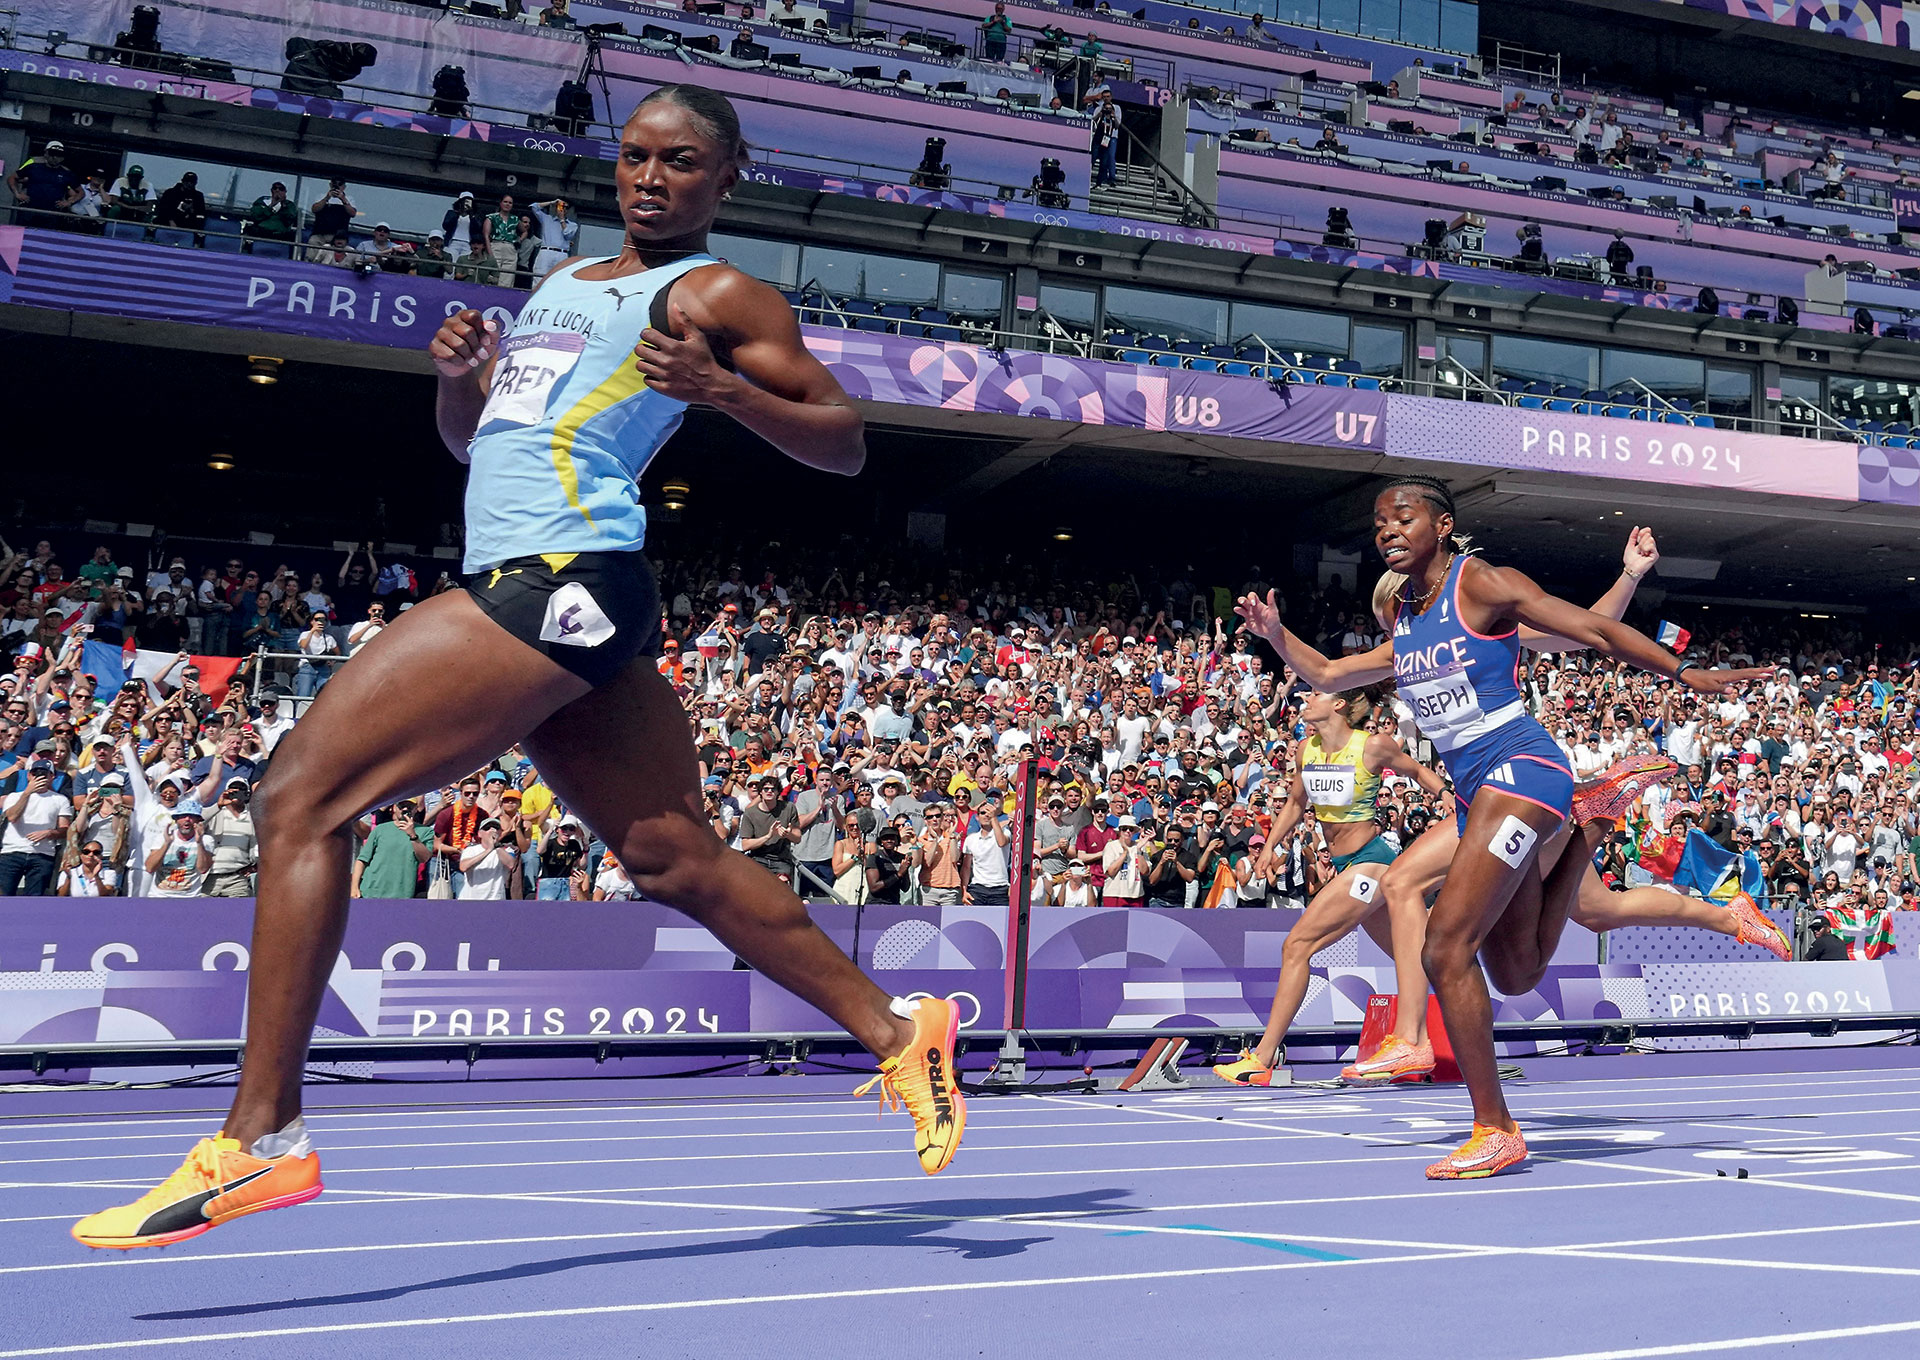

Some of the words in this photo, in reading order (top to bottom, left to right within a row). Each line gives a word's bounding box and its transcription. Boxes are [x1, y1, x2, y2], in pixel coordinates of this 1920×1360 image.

[629, 5, 654, 15] PARIS
[657, 10, 680, 20] 2024
[614, 42, 641, 53] PARIS
[1145, 85, 1172, 107] T8
[72, 112, 94, 127] 10
[1066, 119, 1089, 128] PARIS
[506, 175, 517, 187] 9
[981, 242, 990, 253] 7
[1075, 255, 1085, 266] 6
[1389, 297, 1397, 308] 5
[1467, 307, 1477, 318] 4
[552, 309, 594, 339] LUCIA
[1739, 342, 1747, 352] 3
[1810, 352, 1818, 362] 2
[1174, 395, 1221, 428] U8
[1335, 411, 1378, 444] U7
[1647, 439, 1741, 473] 2024
[1309, 778, 1344, 793] LEWIS
[1013, 808, 1023, 885] OMEGA
[1505, 829, 1526, 855] 5
[1360, 881, 1370, 895] 9
[1784, 990, 1872, 1014] 2024
[588, 1007, 719, 1035] 2024
[926, 1047, 954, 1136] NITRO
